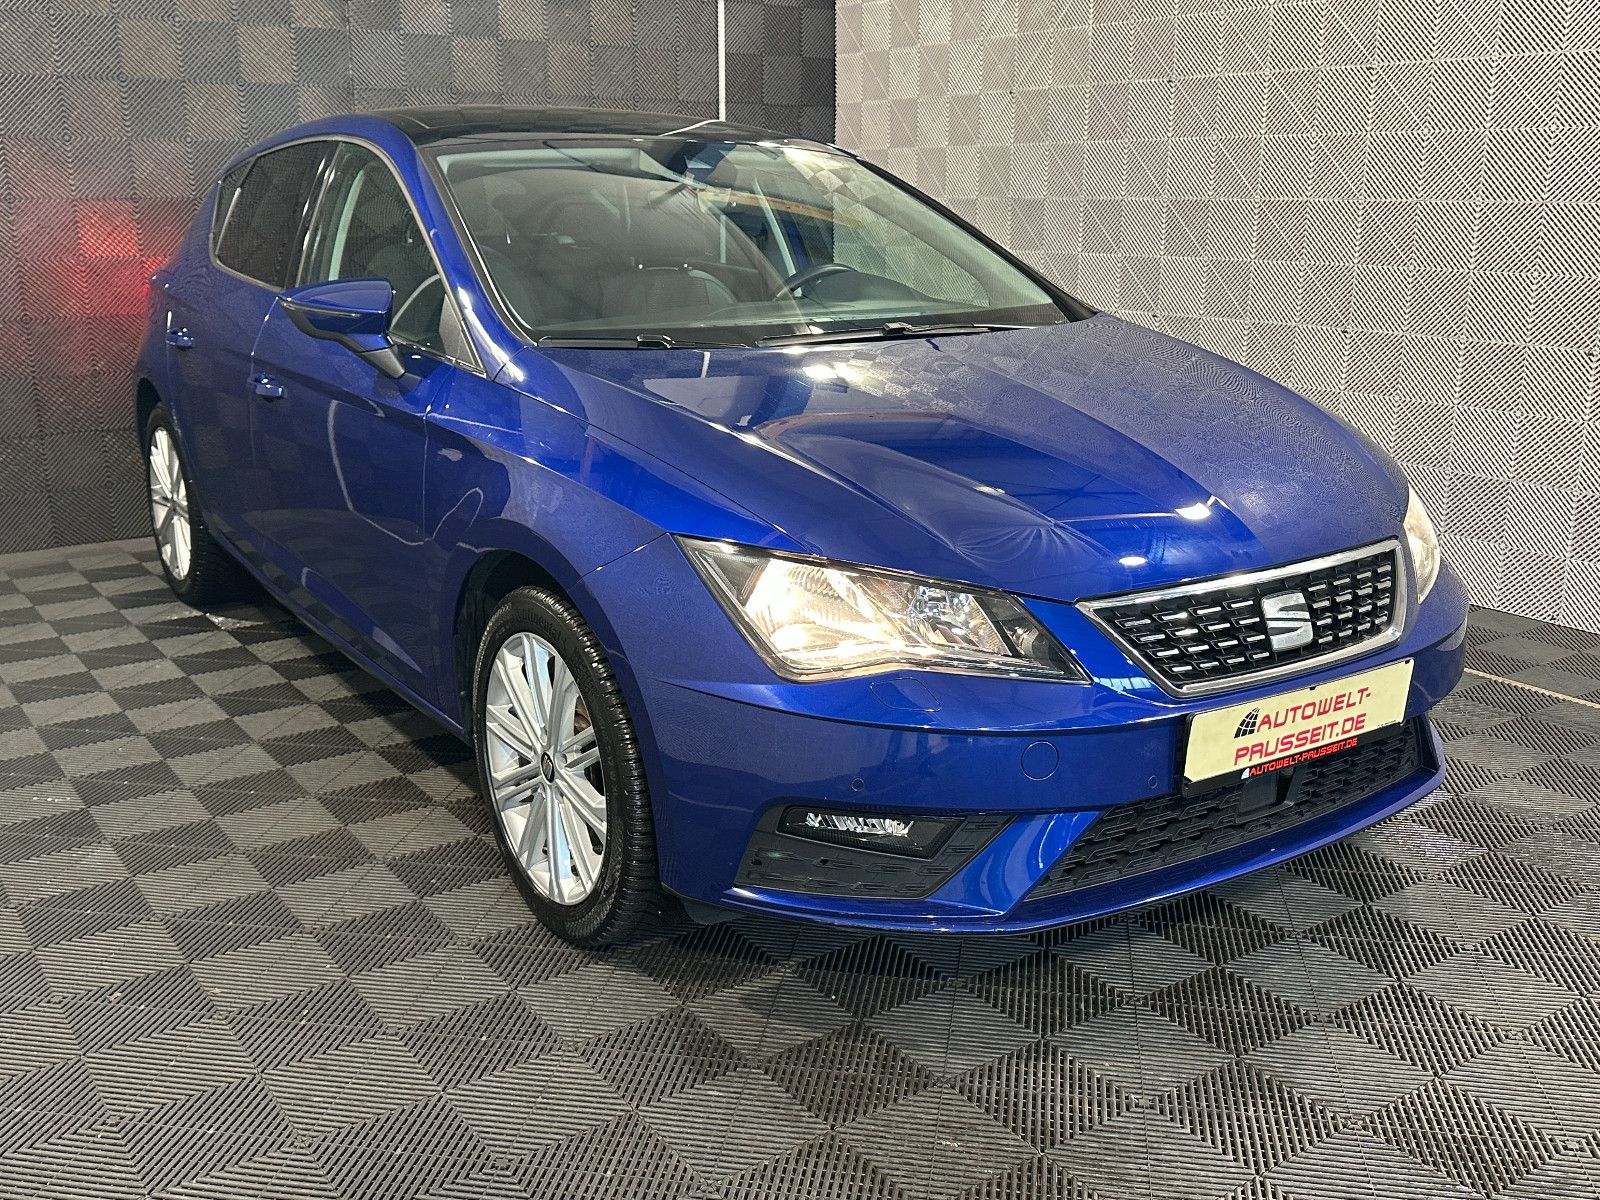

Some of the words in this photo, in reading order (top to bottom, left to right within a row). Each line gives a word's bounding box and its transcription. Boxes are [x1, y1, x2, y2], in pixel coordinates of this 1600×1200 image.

[1256, 687, 1371, 732] AUTOWELT-
[1234, 713, 1367, 766] PRUSSEIT.DE
[1249, 737, 1358, 777] AUTOWELT-PRUSSEIT.DE
